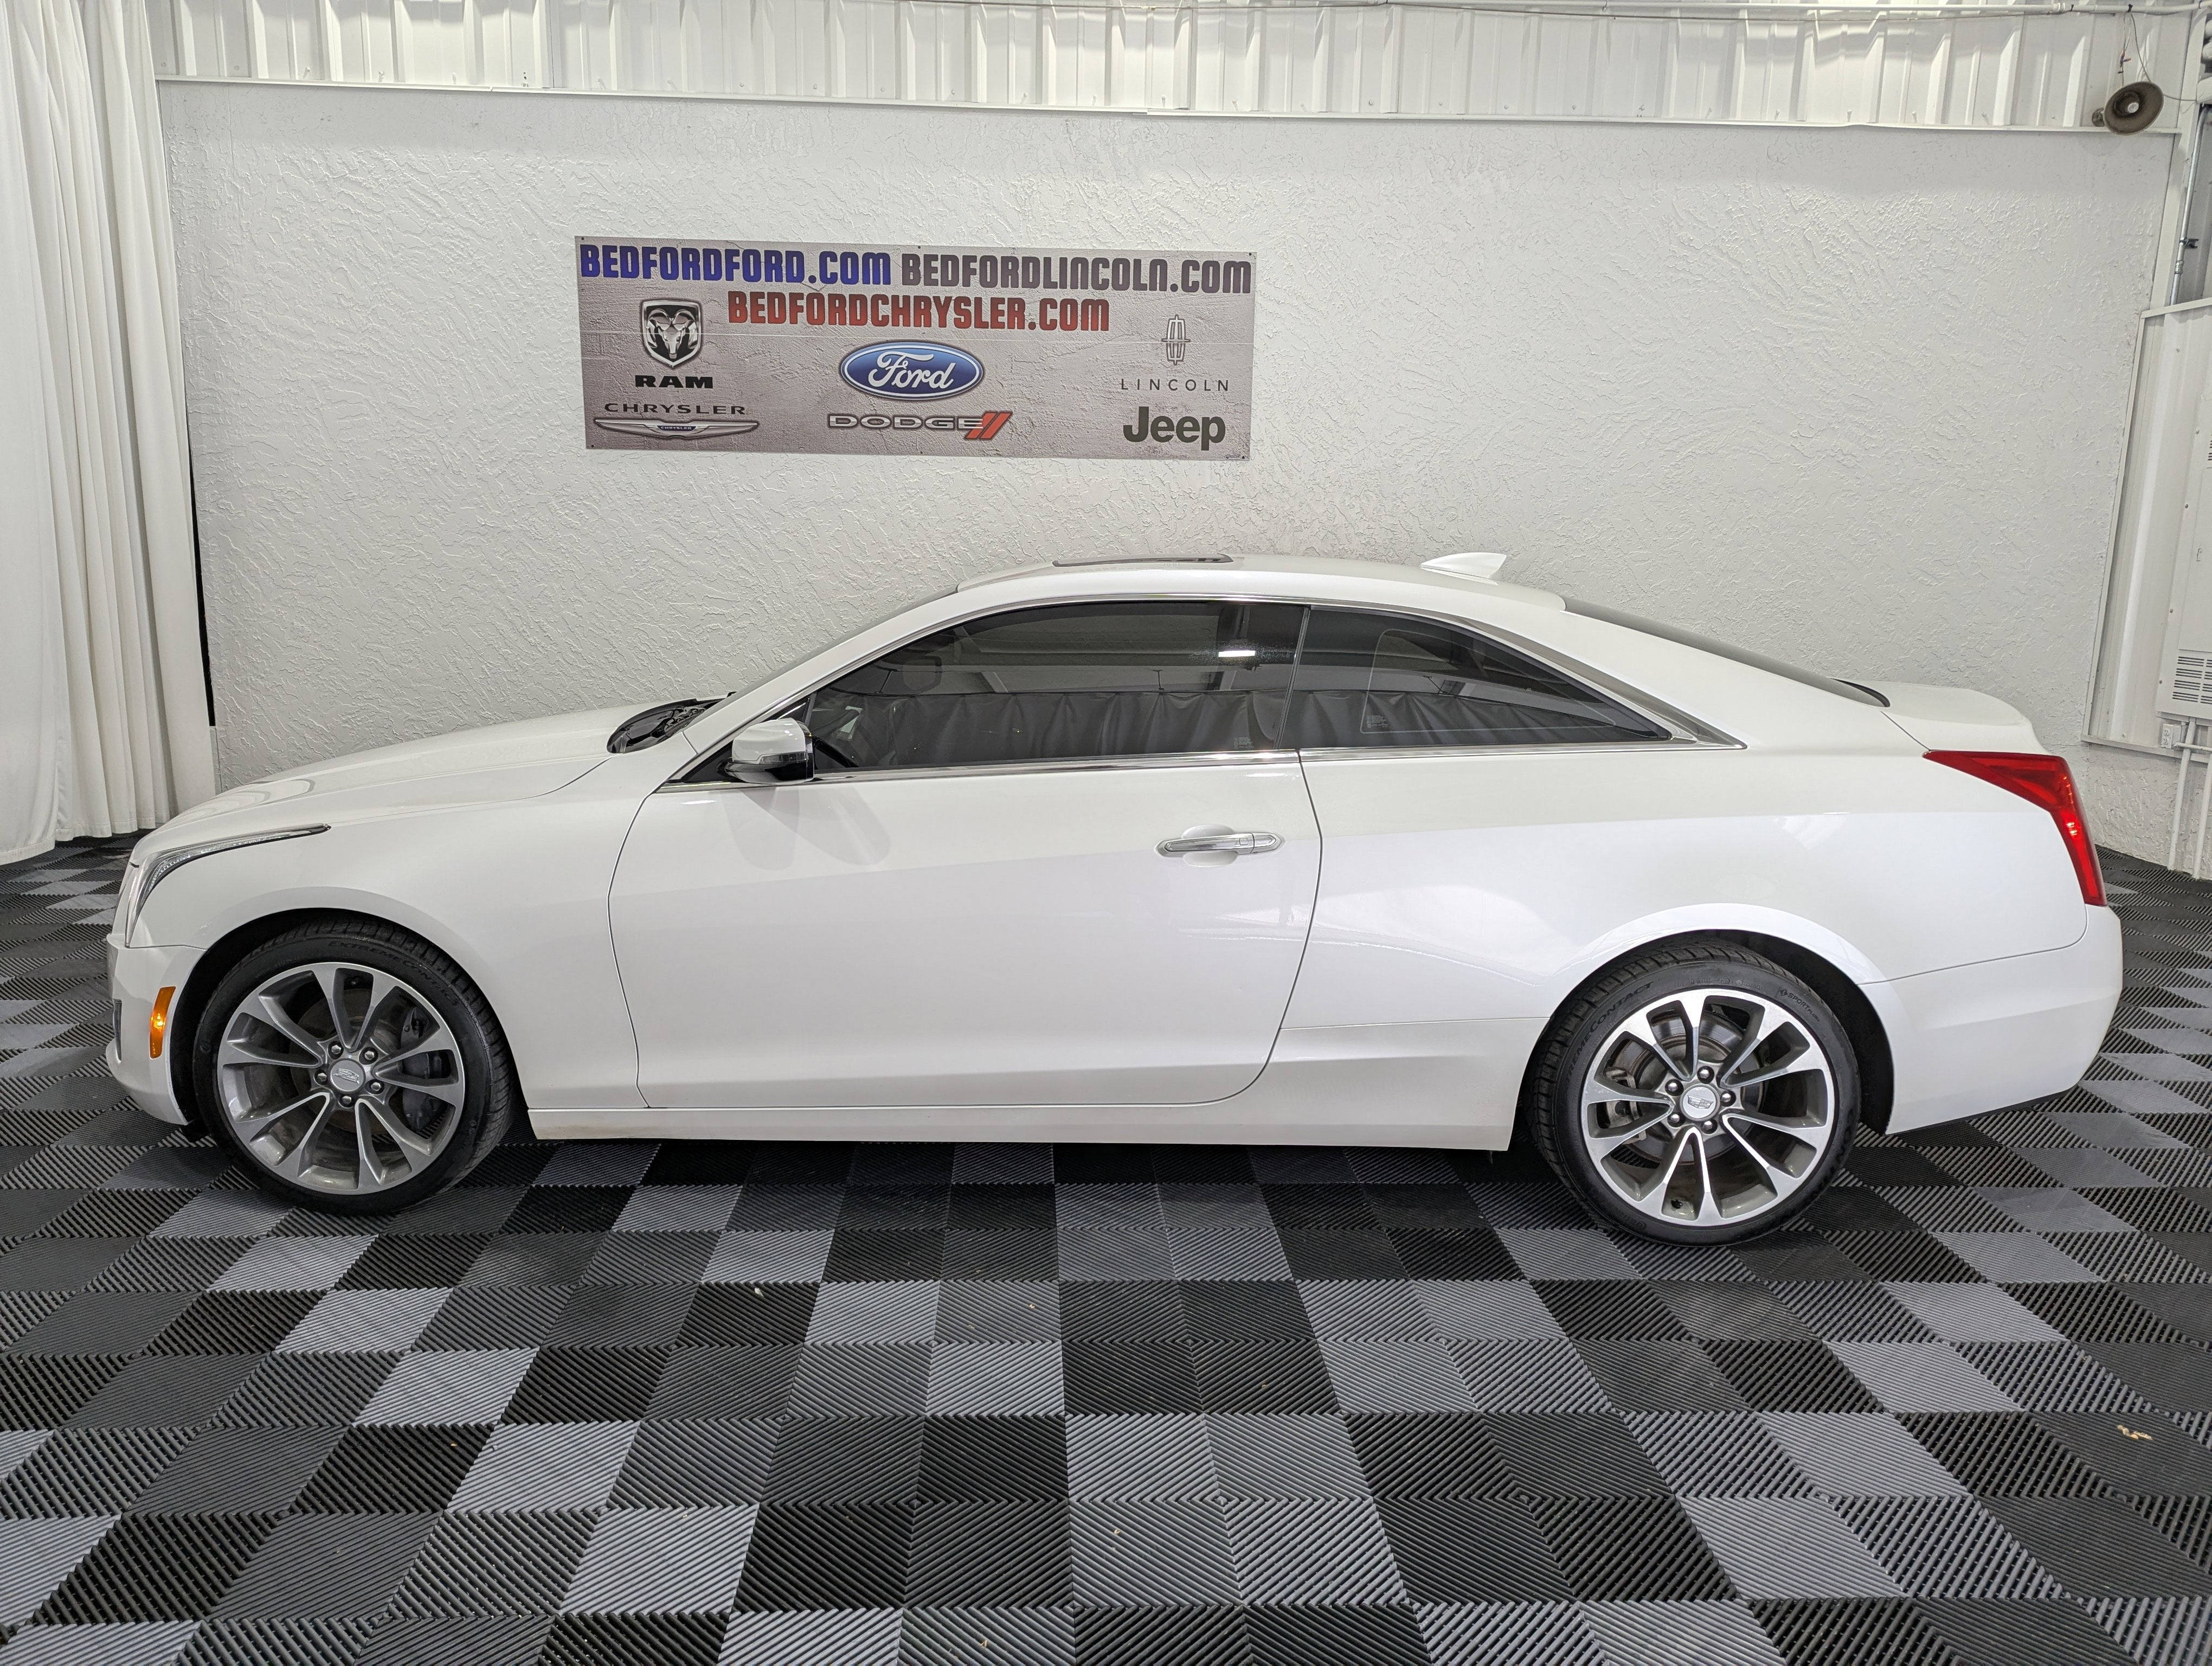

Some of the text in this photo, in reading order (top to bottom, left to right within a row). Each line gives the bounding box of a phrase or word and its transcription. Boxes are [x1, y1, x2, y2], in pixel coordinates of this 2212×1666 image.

[580, 244, 1252, 294] BEDFORDFORD.COM BEDFORDLINCOLN.COM
[728, 291, 1109, 331] BEDFORDCHRYSLER.COM
[635, 374, 713, 389] RAM
[868, 350, 956, 388] Ford
[1121, 378, 1229, 392] LINCOLN
[605, 402, 745, 415] CHRYSLER
[829, 414, 984, 431] DODGE
[1123, 406, 1226, 451] Jeep
